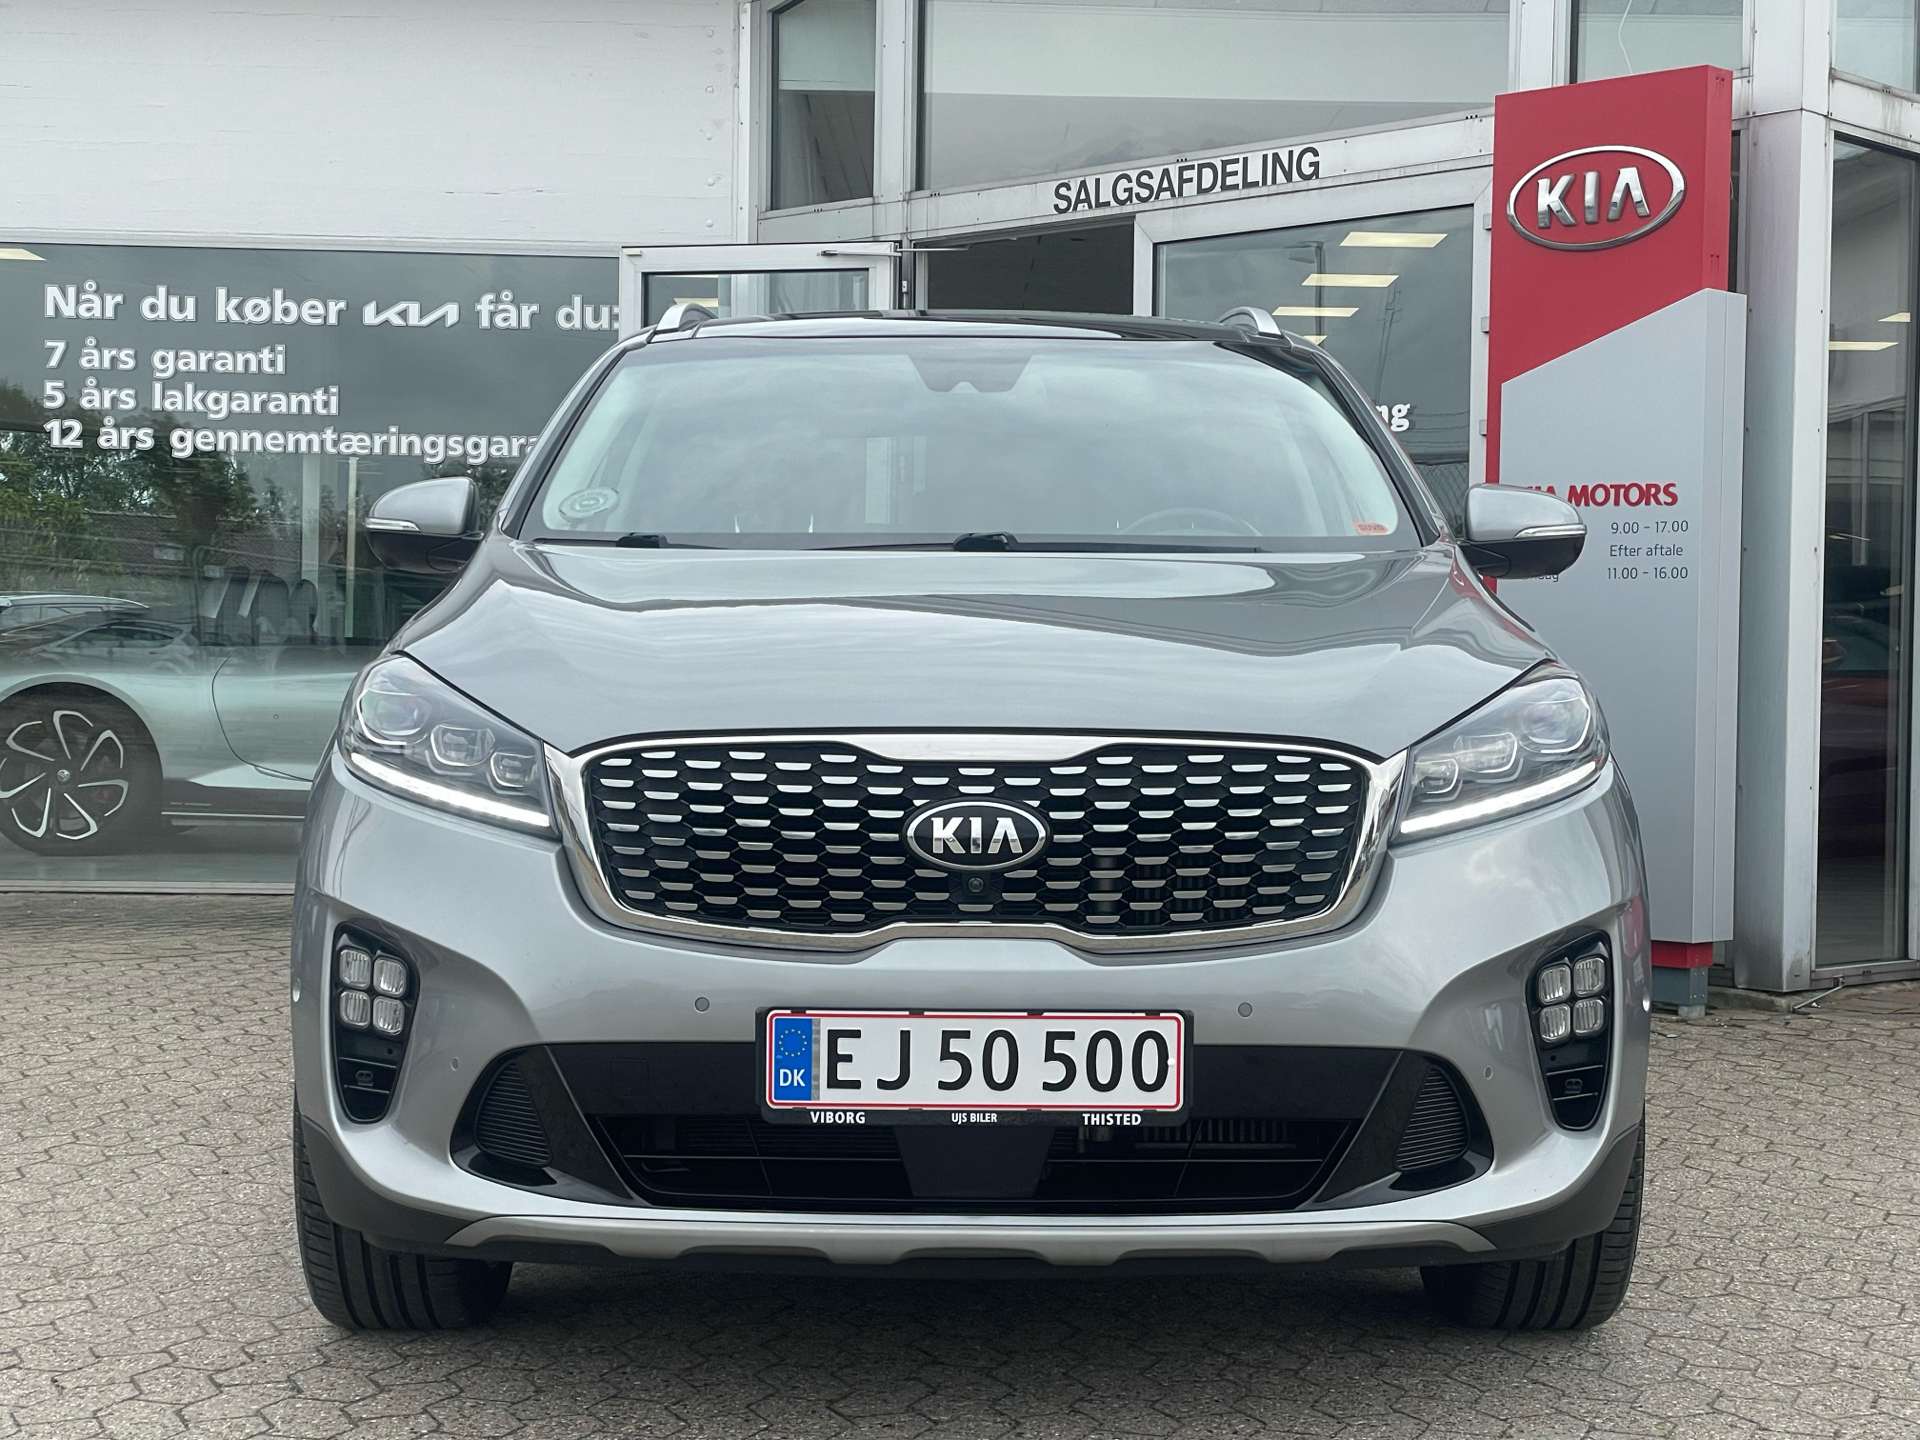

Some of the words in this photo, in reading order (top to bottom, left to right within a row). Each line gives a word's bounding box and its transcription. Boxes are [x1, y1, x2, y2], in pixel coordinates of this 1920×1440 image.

[1053, 146, 1320, 214] SALGSAFDELING
[1537, 166, 1651, 230] KIA
[45, 280, 124, 319] Når
[140, 285, 196, 321] du
[215, 287, 347, 325] køber
[475, 289, 540, 329] får
[45, 340, 66, 368] 7
[79, 337, 136, 370] års
[152, 344, 286, 378] garanti
[43, 380, 65, 409] 5
[79, 376, 137, 410] års
[152, 381, 339, 420] lakgaranti
[43, 418, 83, 447] 12
[97, 416, 154, 450] års
[1567, 482, 1679, 507] MOTORS
[1611, 522, 1640, 534] 9.00
[1655, 520, 1689, 533] 17.00
[1609, 544, 1642, 557] Efter
[1646, 544, 1683, 556] aftale
[1607, 567, 1638, 579] 11.00
[1653, 566, 1688, 579] 16.00
[931, 817, 1023, 853] KIA
[826, 1028, 911, 1091] EJ
[937, 1029, 1019, 1092] 50
[1042, 1029, 1169, 1092] 500
[779, 1068, 806, 1087] DK
[810, 1111, 866, 1124] VIBORG
[969, 1112, 998, 1123] BILER
[1082, 1112, 1142, 1126] THISTED
